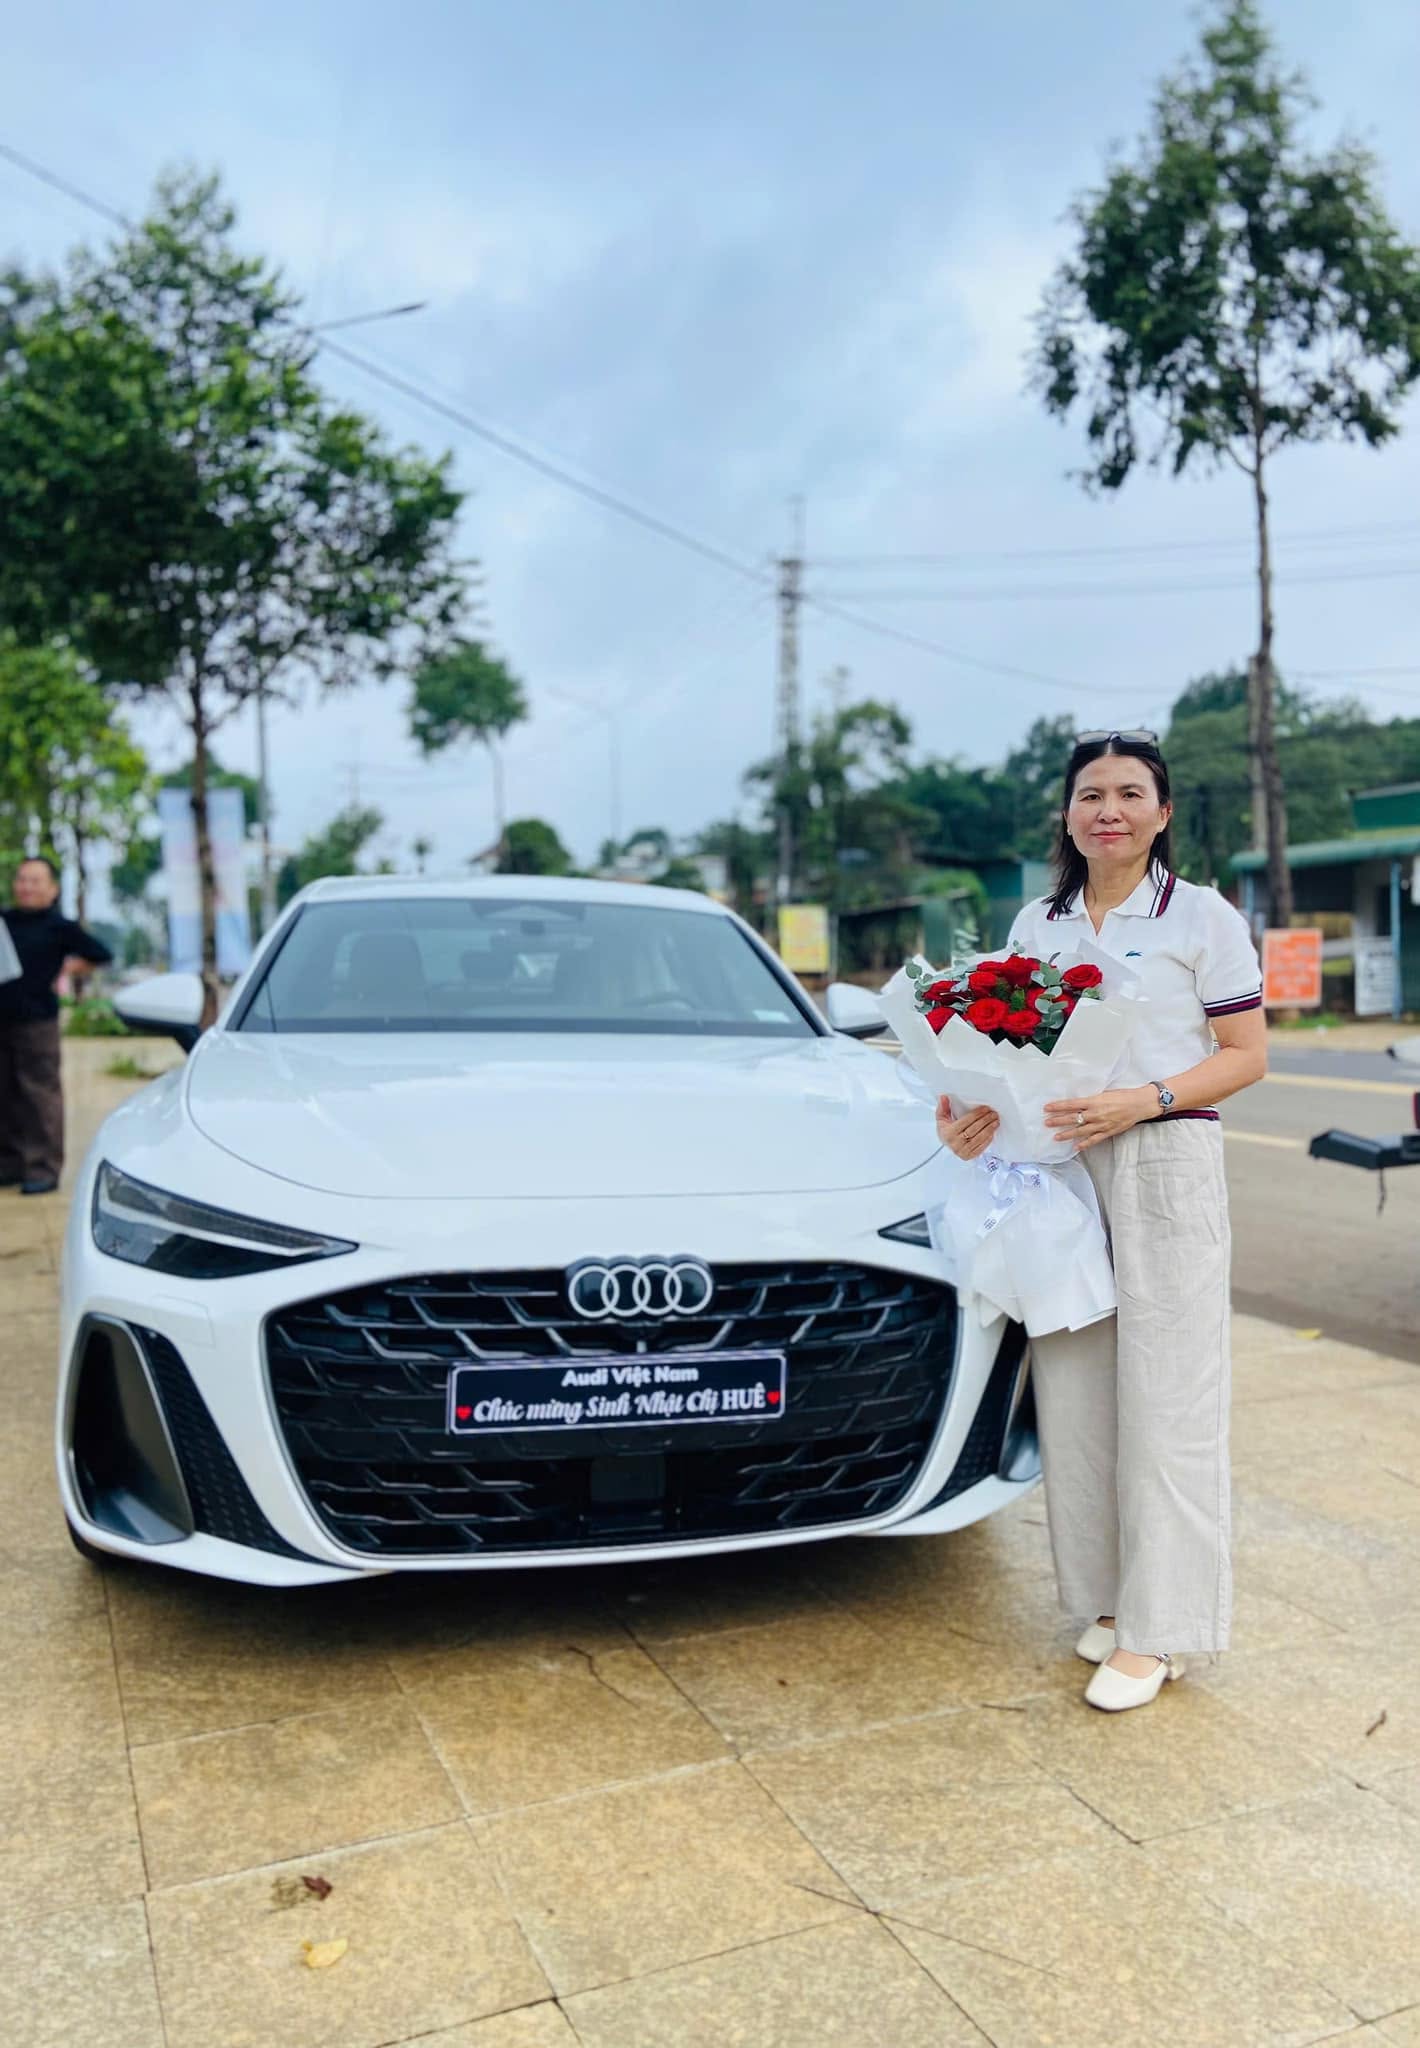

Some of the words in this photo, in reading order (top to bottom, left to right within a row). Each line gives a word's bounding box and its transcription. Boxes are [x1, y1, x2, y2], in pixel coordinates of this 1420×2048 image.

[561, 1369, 608, 1387] Audi
[611, 1366, 651, 1388] Việt
[653, 1367, 699, 1383] Nam
[473, 1397, 525, 1422] Chúc
[585, 1391, 631, 1418] Sinh
[634, 1390, 684, 1417] Nhật
[686, 1388, 719, 1415] Chị
